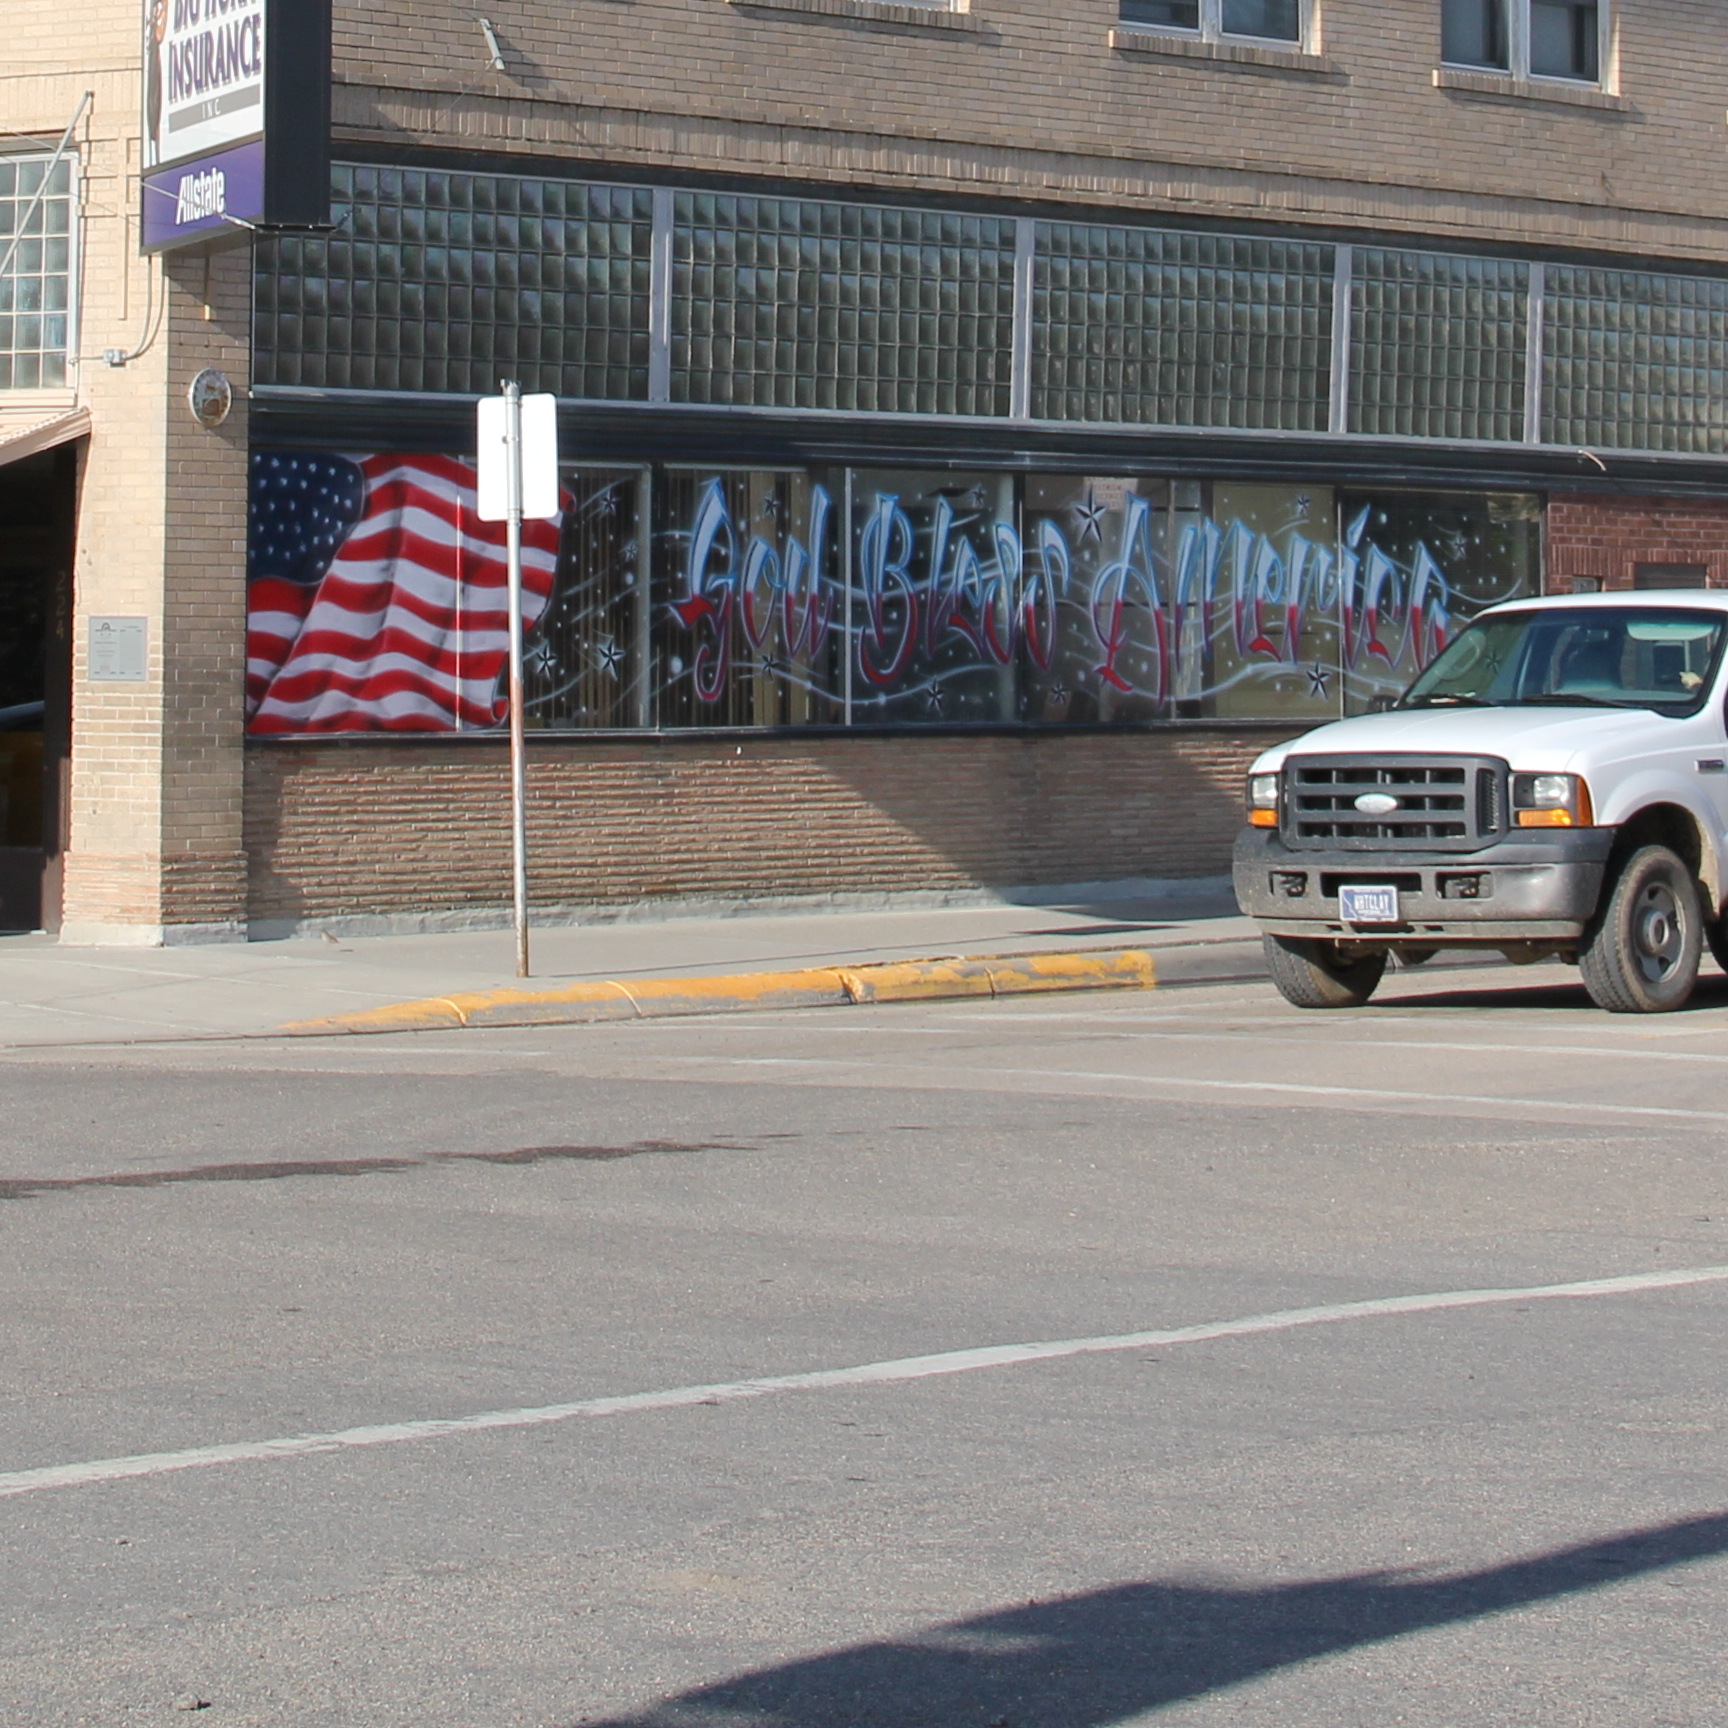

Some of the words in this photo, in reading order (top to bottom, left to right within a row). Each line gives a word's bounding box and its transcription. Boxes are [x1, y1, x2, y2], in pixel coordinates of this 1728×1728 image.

[168, 12, 262, 104] INSURANCE
[202, 99, 222, 119] INC
[175, 167, 227, 225] Allstate
[669, 477, 834, 703] God
[859, 491, 1070, 683] Bless
